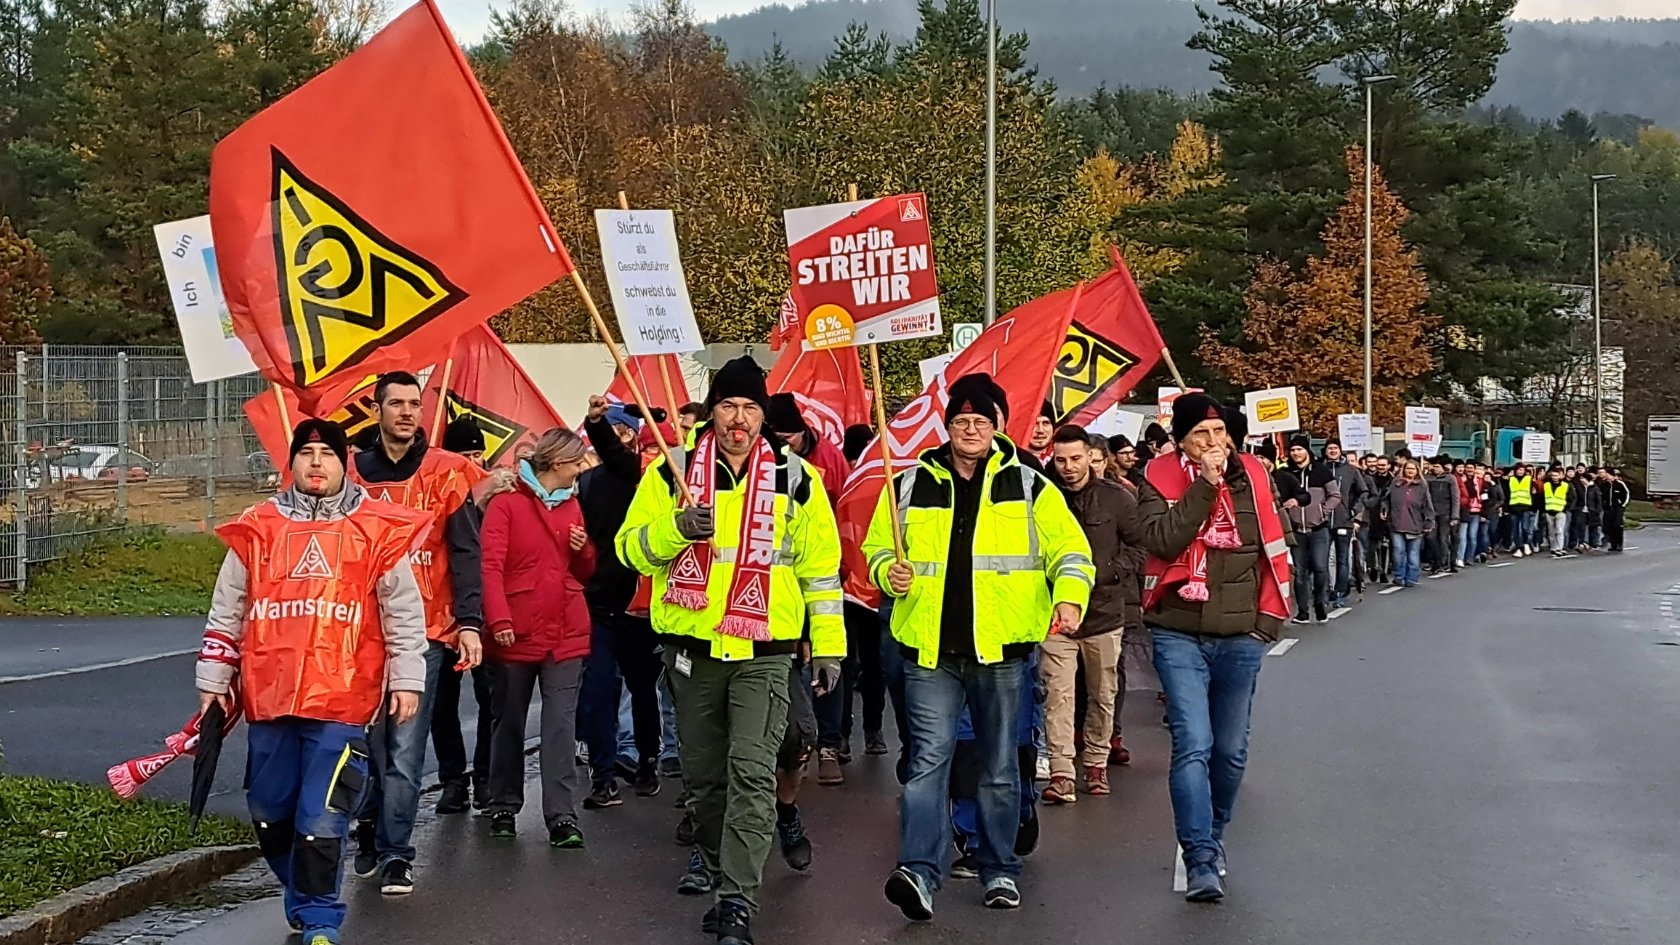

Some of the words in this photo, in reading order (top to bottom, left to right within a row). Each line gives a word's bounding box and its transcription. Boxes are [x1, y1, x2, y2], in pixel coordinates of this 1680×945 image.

[617, 221, 643, 234] Stürzt
[644, 221, 655, 234] du
[172, 234, 193, 259] bin
[636, 243, 647, 254] als
[830, 227, 894, 255] DAFÜR
[798, 244, 928, 285] STREITEN
[183, 282, 199, 307] Ich
[625, 284, 665, 297] schwebst
[666, 284, 677, 297] du
[852, 275, 911, 306] WIR
[645, 305, 655, 316] in
[655, 305, 666, 316] die
[639, 324, 681, 343] Holding
[747, 461, 775, 566] MEHR
